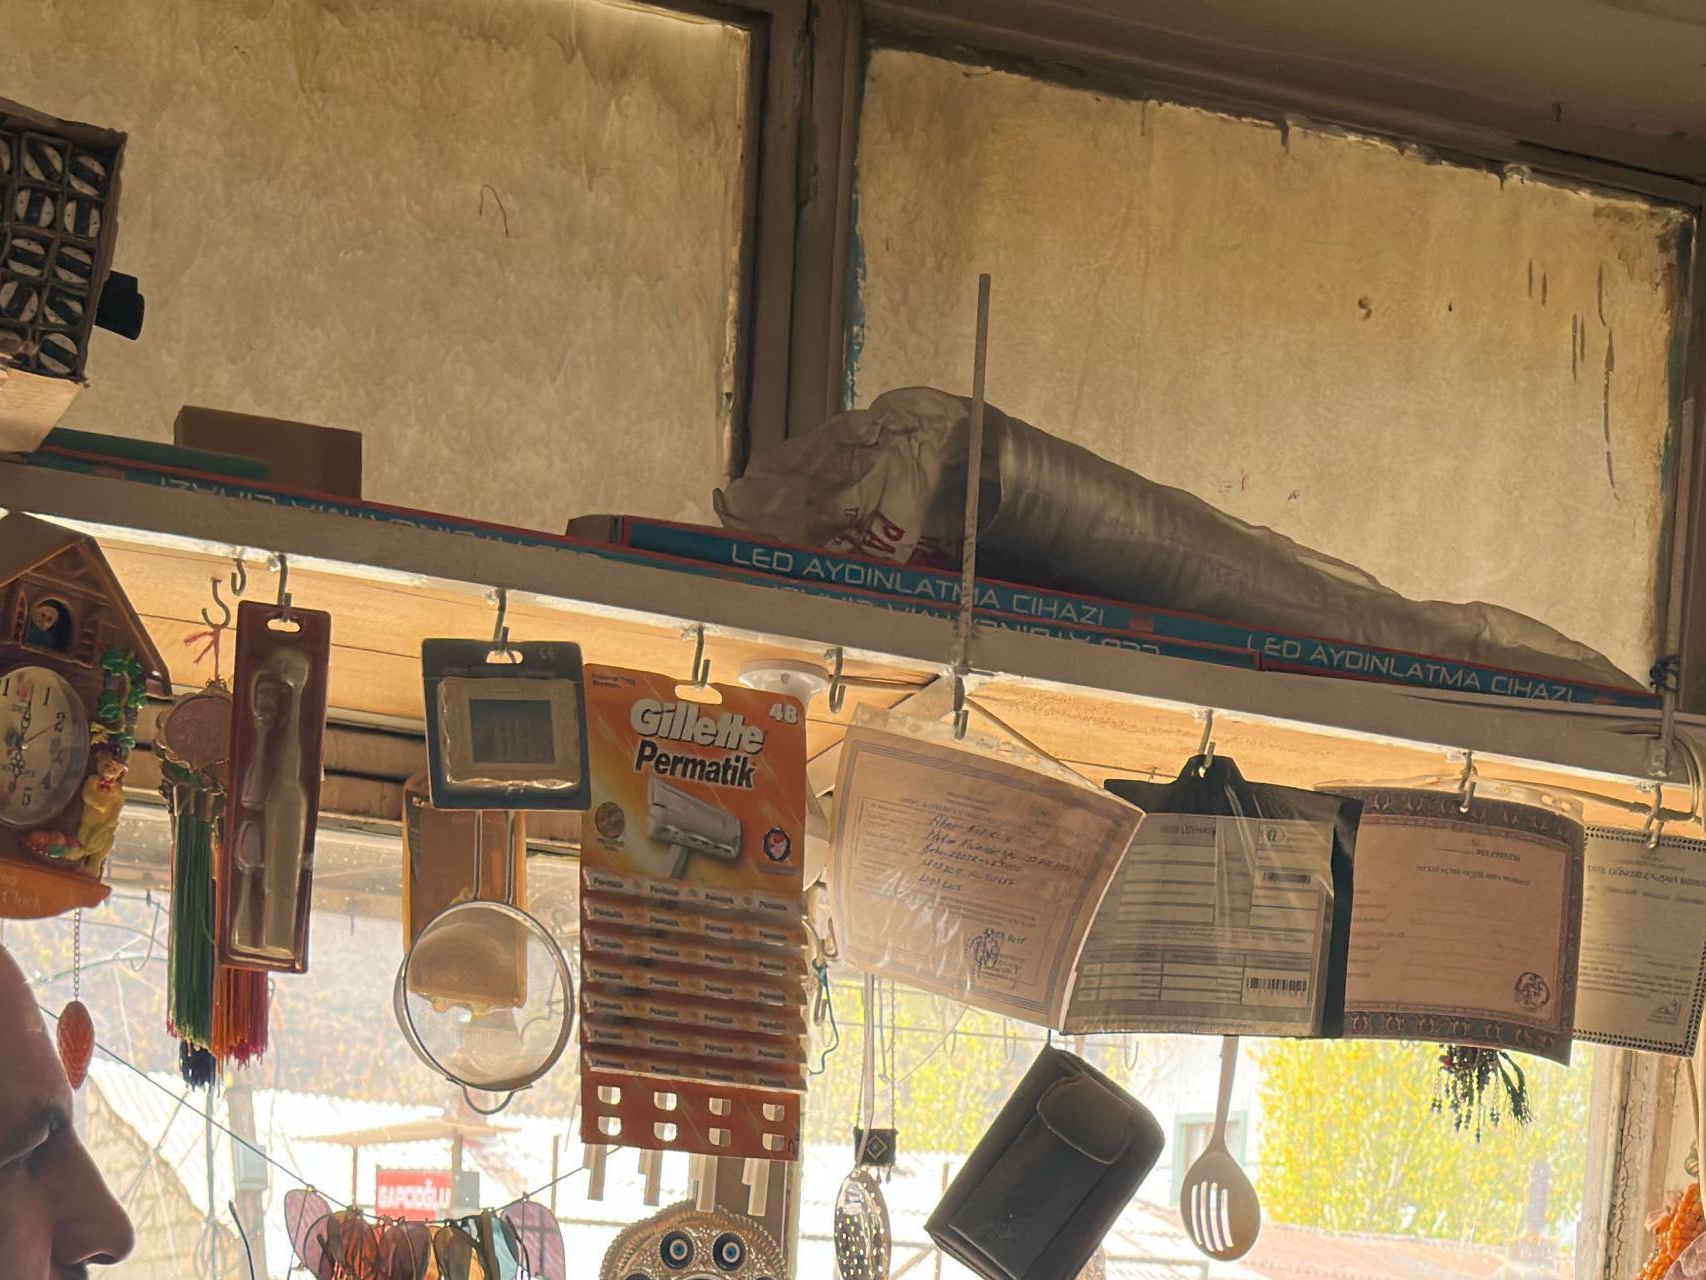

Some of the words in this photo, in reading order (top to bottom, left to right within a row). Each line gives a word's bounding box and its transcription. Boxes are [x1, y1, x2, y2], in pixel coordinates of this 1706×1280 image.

[732, 543, 793, 574] LED
[802, 557, 1002, 610] AYDINLATMA
[1012, 594, 1105, 627] CIHAZI
[1247, 633, 1301, 661] LED
[1309, 644, 1482, 692] AYDINLATMA
[630, 698, 765, 755] Gillette
[768, 703, 799, 725] 48
[634, 740, 757, 789] Permatik
